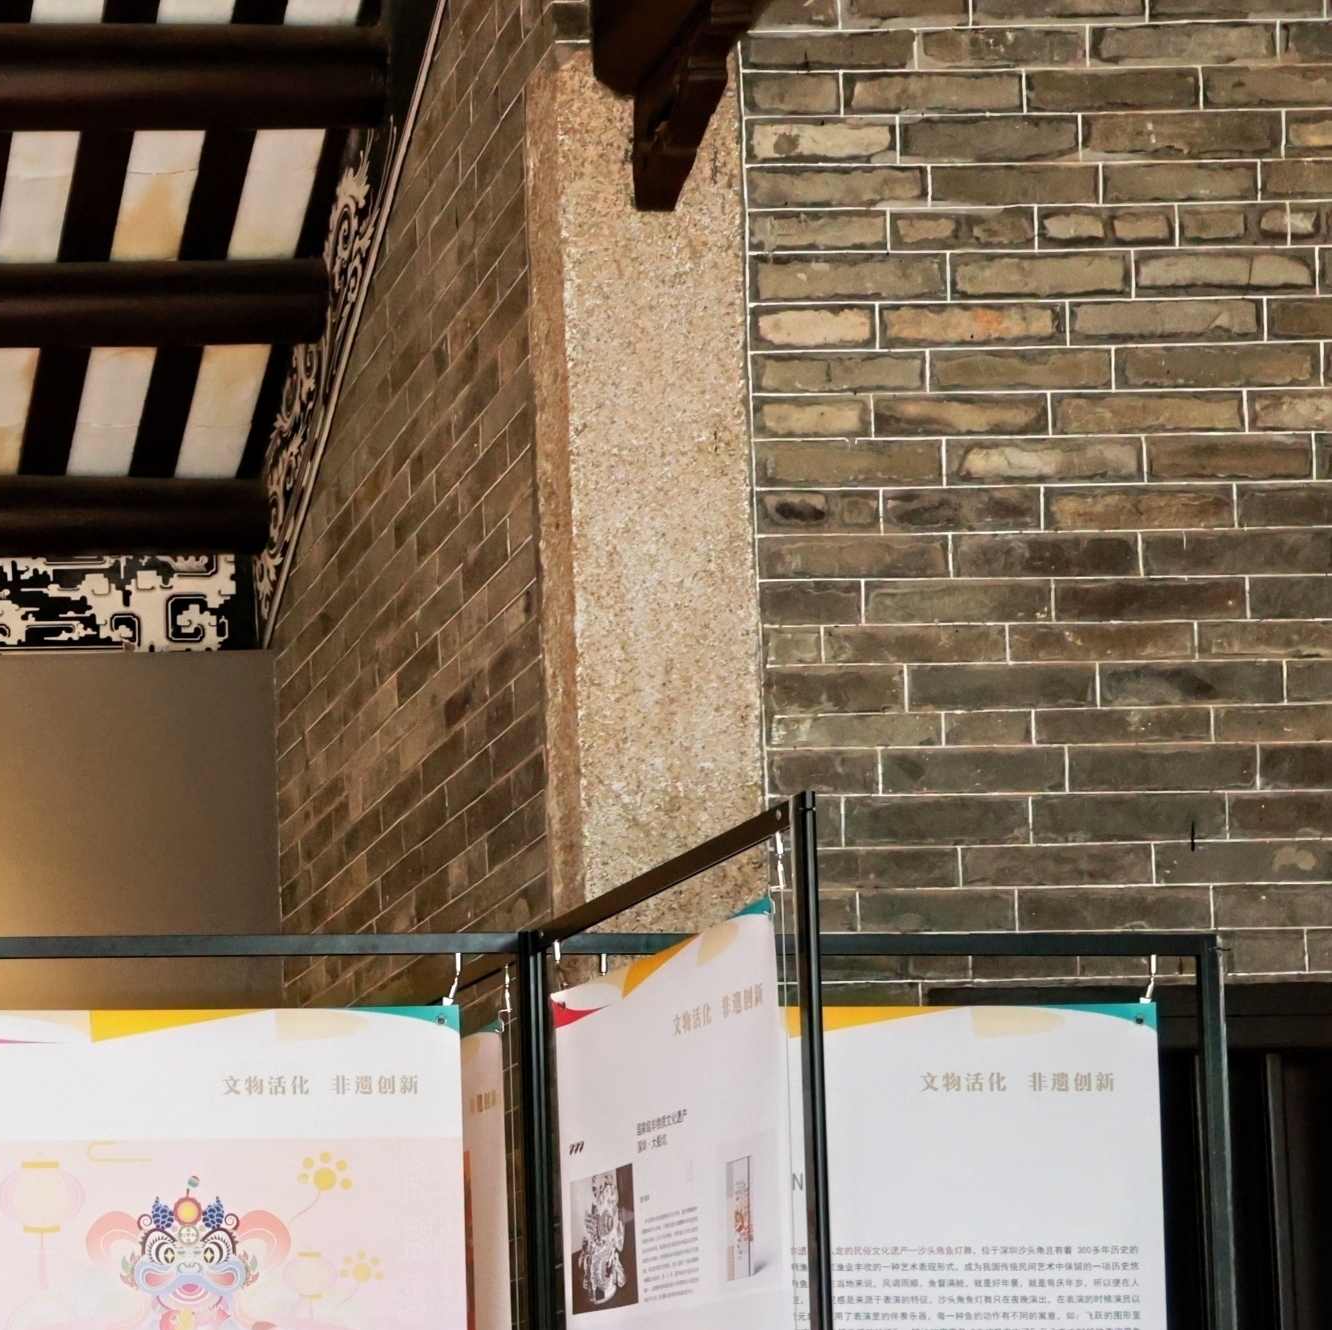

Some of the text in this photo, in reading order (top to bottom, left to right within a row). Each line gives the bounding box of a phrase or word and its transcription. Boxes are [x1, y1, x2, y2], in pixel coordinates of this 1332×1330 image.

[672, 983, 764, 1037] 文物活化 非遗创新
[222, 1074, 420, 1095] 文物活化 非遗创新
[920, 1071, 1115, 1092] 文物活化 非遗创新
